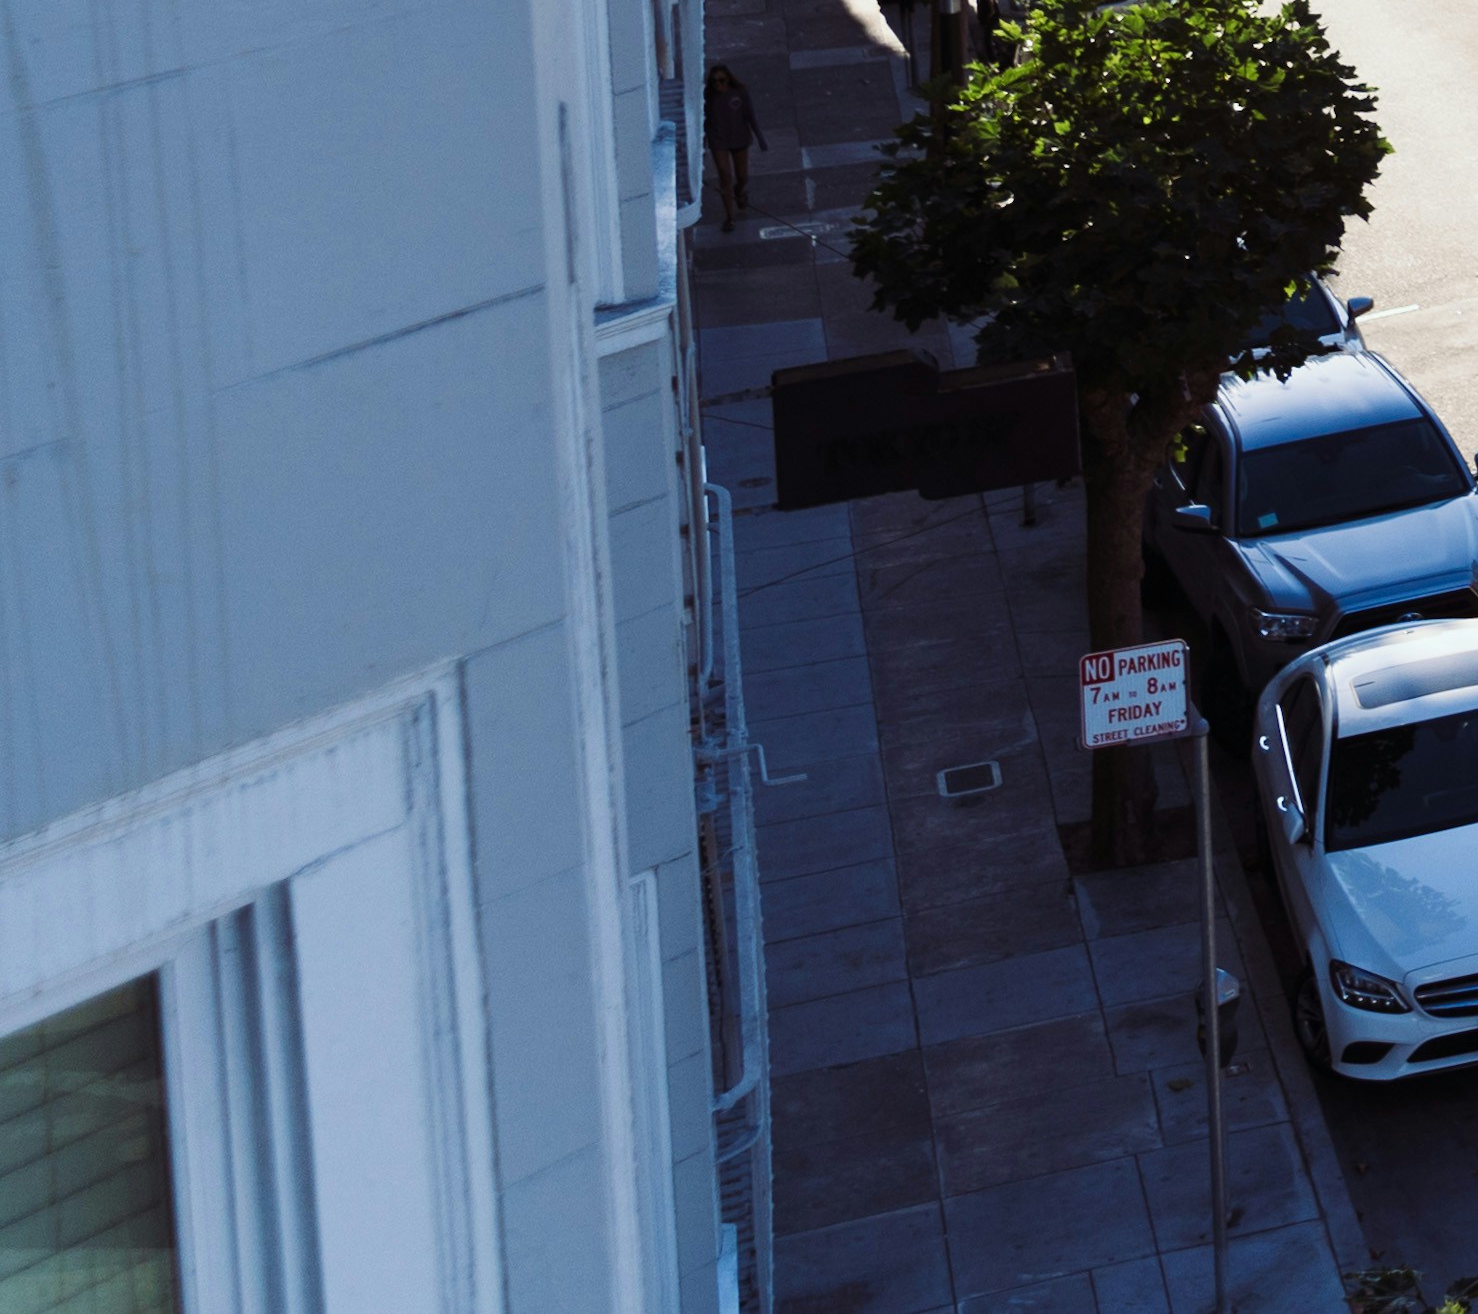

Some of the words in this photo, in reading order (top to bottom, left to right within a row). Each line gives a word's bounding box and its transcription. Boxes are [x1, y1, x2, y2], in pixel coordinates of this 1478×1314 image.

[1085, 656, 1110, 682] NO
[1118, 649, 1181, 676] PARKING
[1108, 701, 1163, 724] FRIDAY
[1092, 729, 1129, 744] STREET
[1133, 720, 1181, 736] CLEANING
